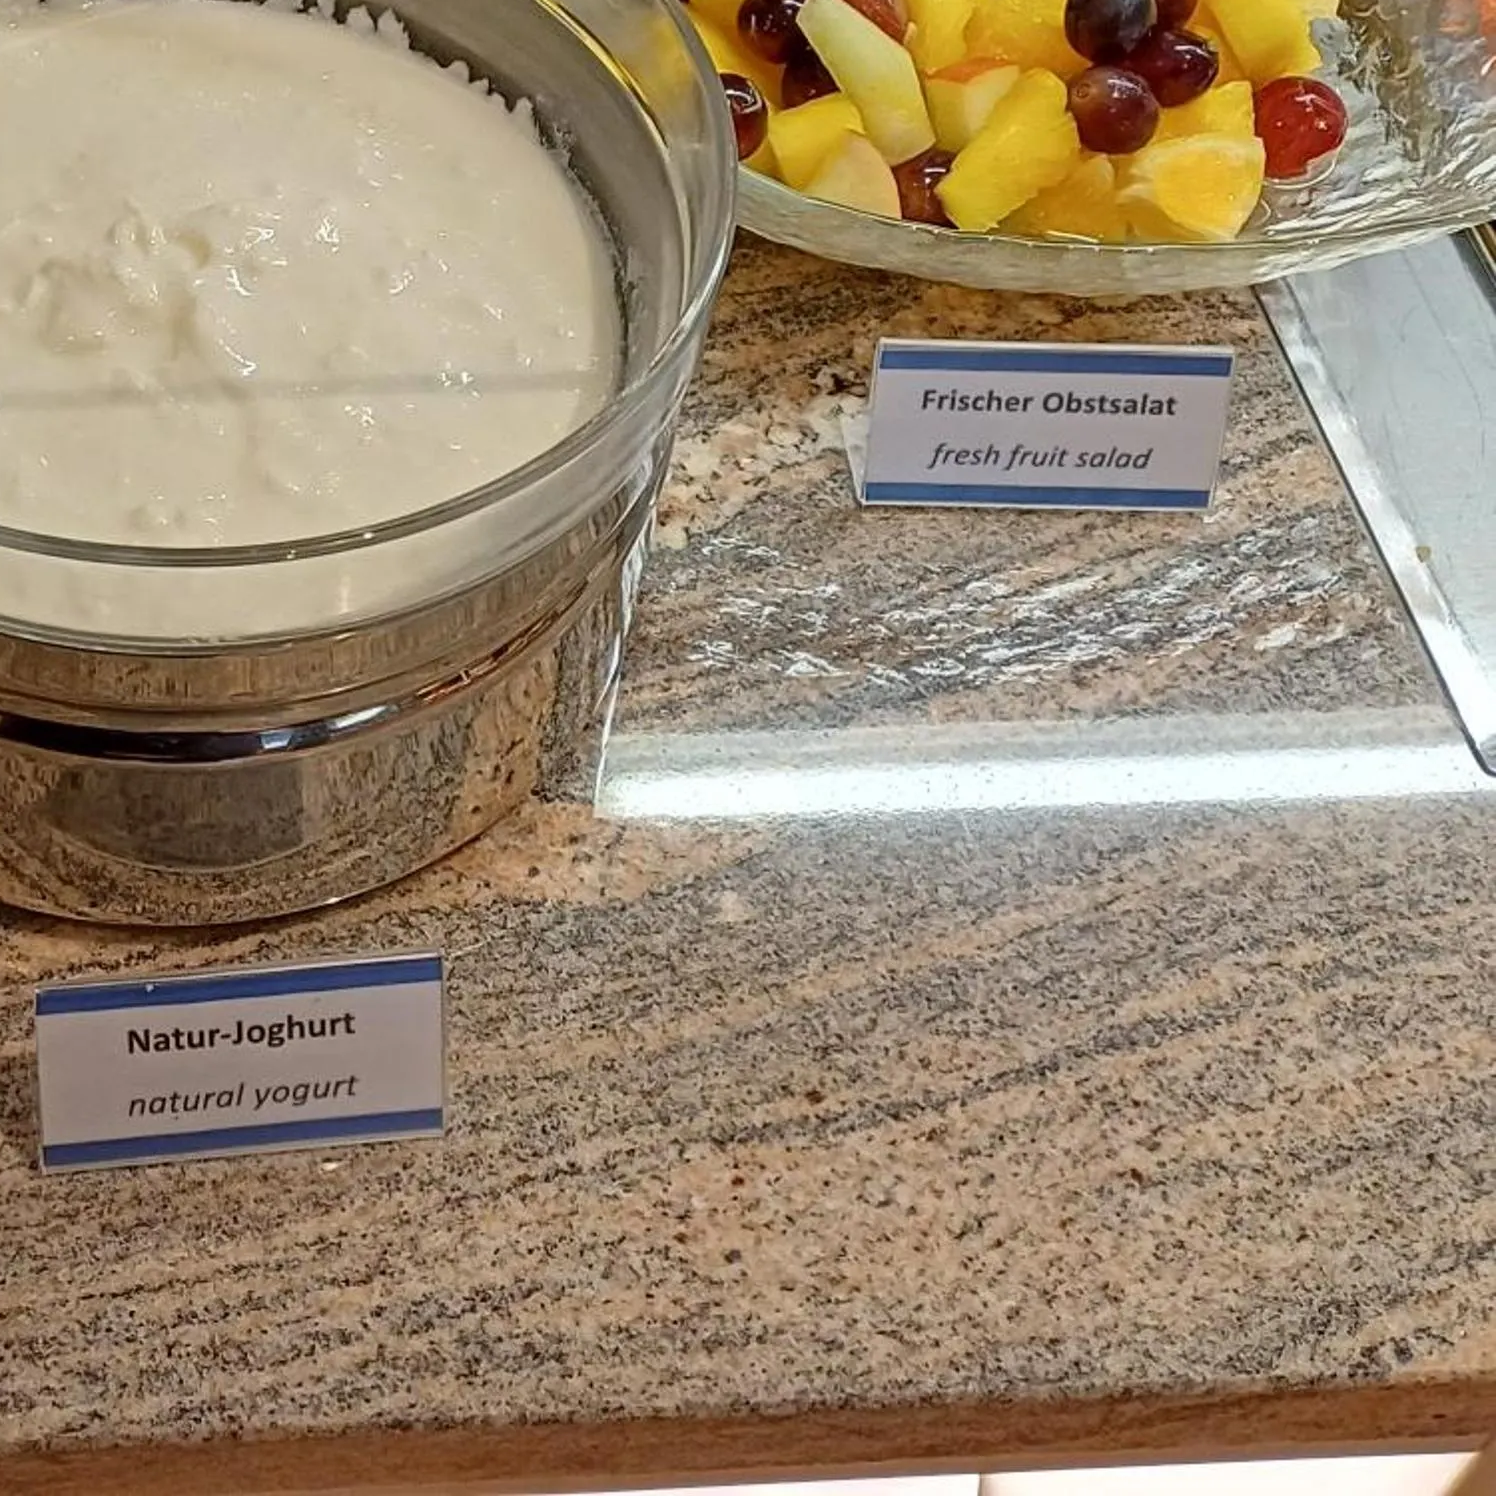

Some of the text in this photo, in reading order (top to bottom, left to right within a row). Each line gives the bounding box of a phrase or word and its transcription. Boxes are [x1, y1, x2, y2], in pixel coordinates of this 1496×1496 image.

[922, 389, 1178, 416] Frischer Obstsalat
[927, 442, 1154, 471] fresh fruit salad
[127, 1011, 356, 1054] Natur-Joghurt
[128, 1074, 360, 1117] natural yogurt
